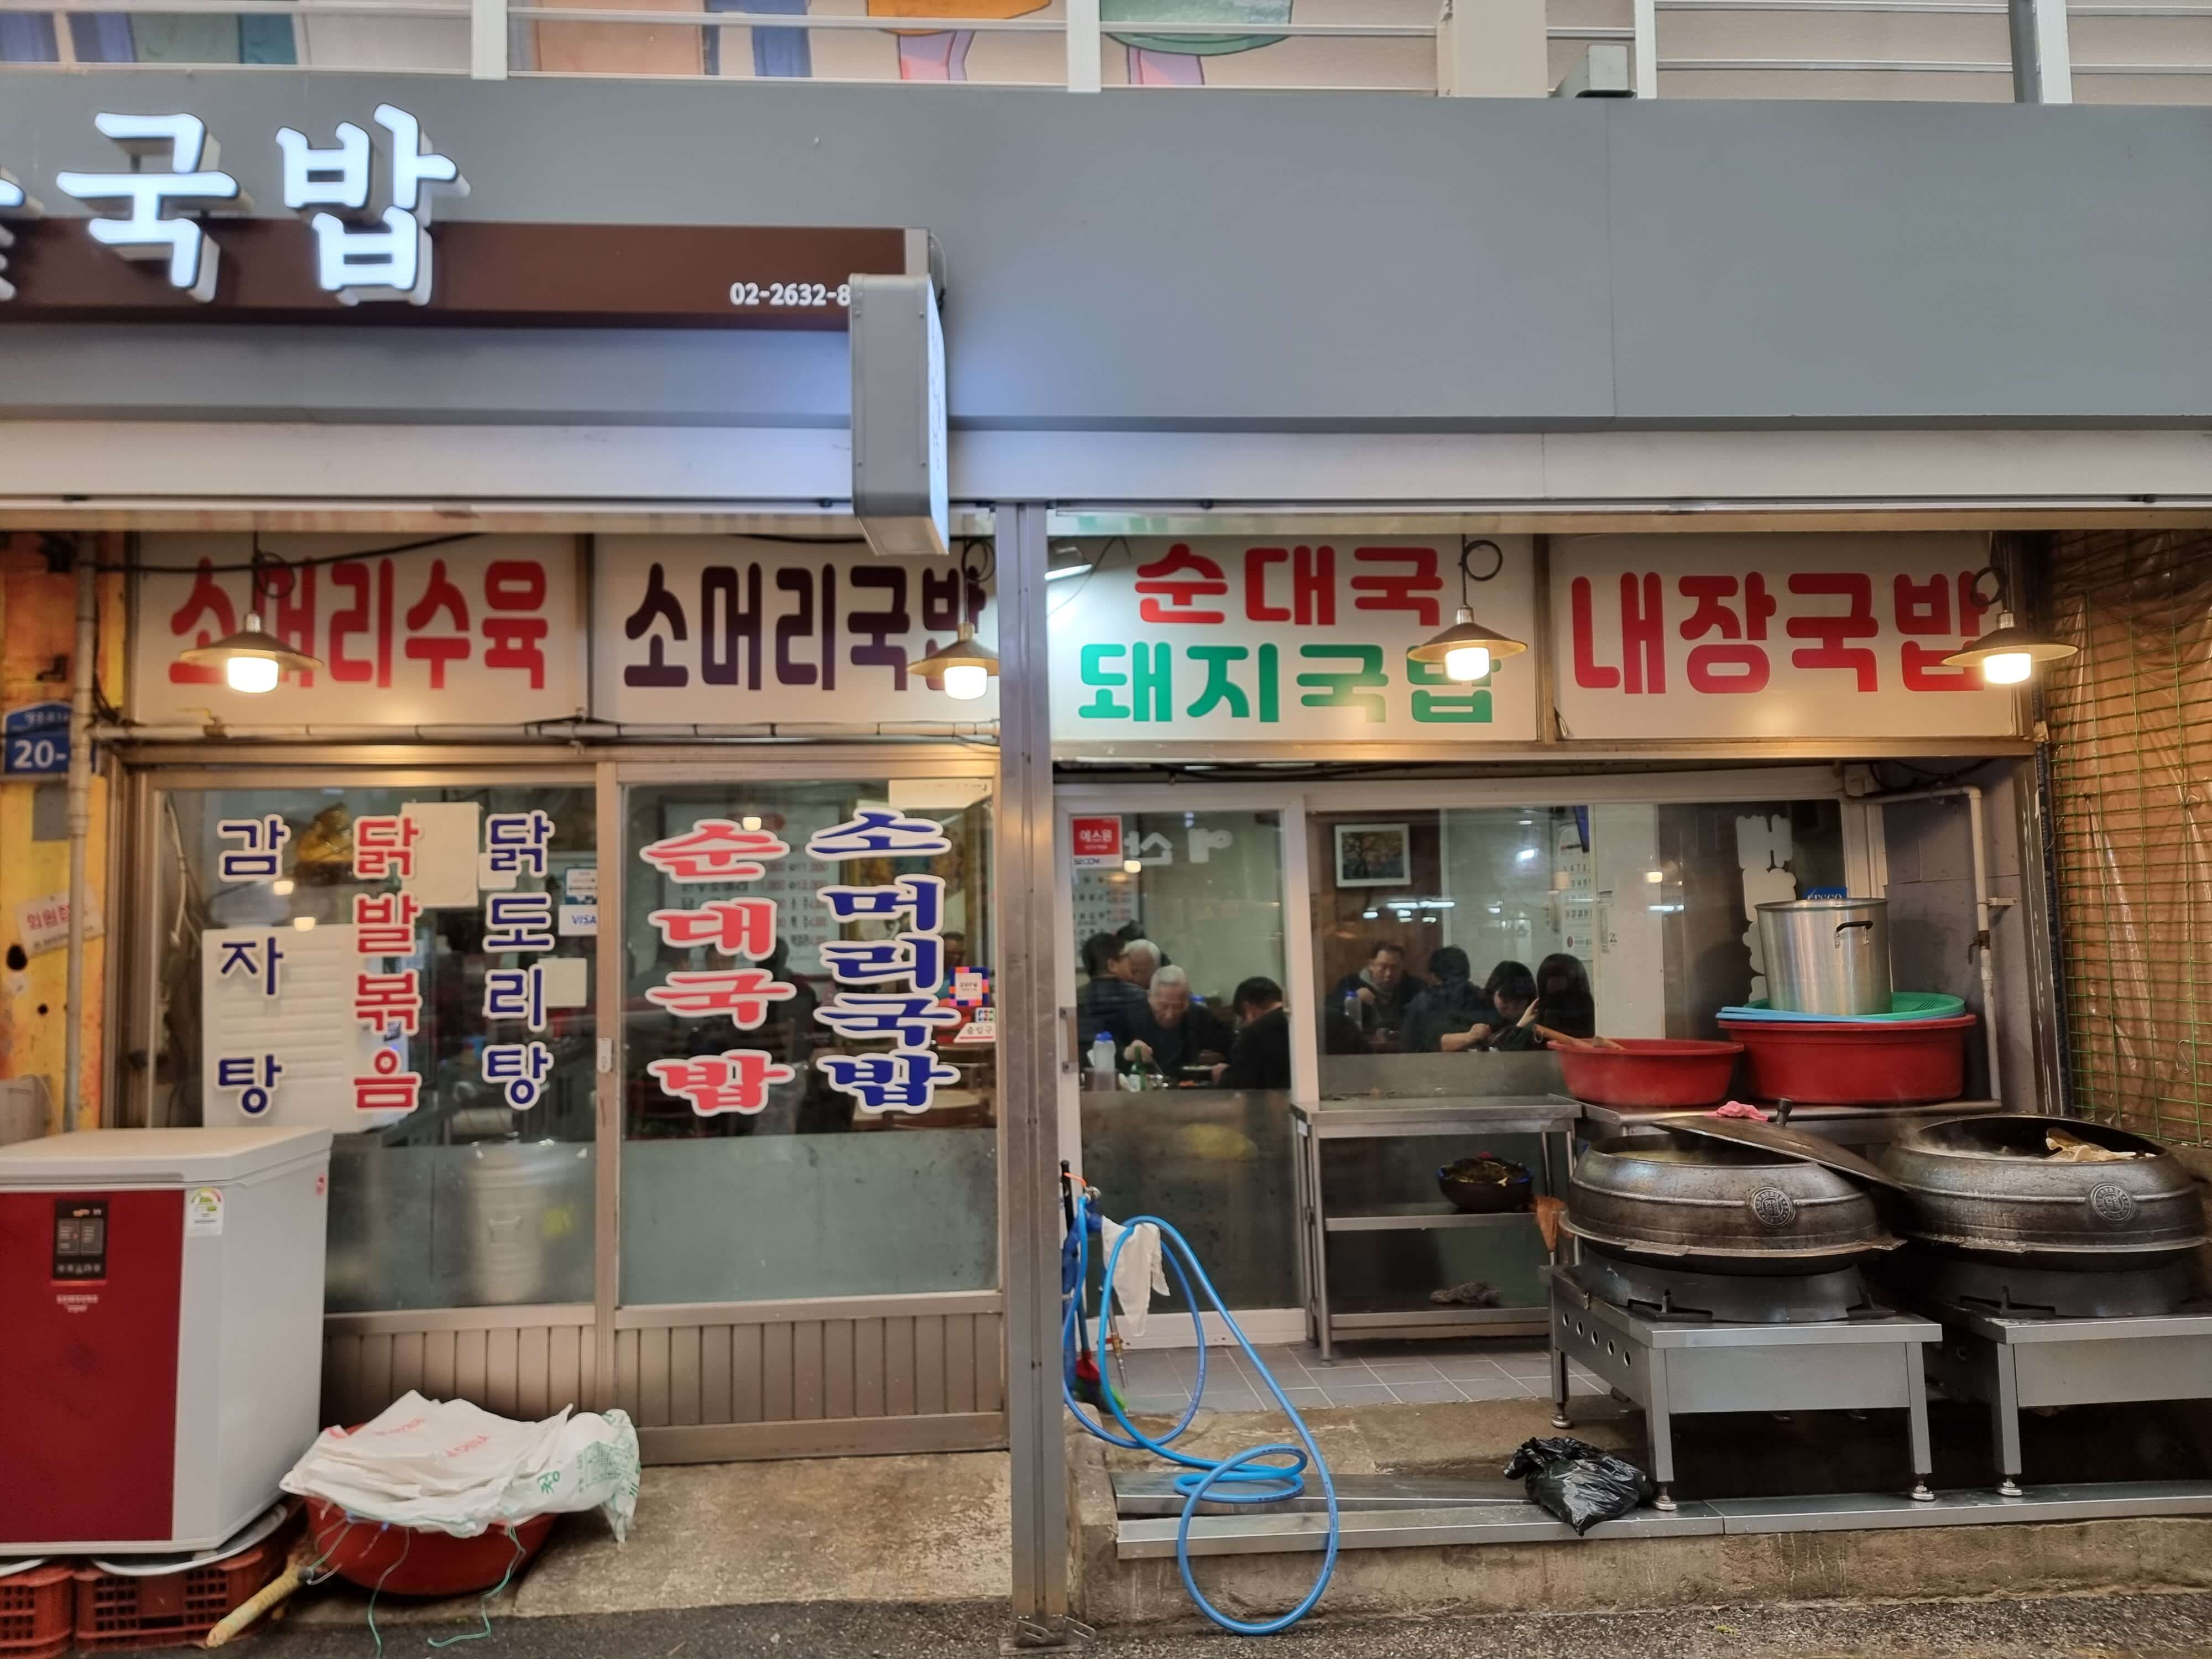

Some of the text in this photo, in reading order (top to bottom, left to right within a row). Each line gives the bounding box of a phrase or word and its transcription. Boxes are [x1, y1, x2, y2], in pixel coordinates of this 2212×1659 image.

[0, 103, 460, 294] 국밥
[729, 282, 851, 306] 02-2632-8
[1135, 543, 1443, 625] 순대국
[1572, 571, 1990, 695] 내장국밥
[571, 915, 597, 925] VISA
[1079, 830, 1113, 842] 에스원
[217, 817, 288, 1115] 감자탕
[353, 815, 422, 1110] 닭발볶음
[483, 813, 554, 1107] 닭도리탕
[642, 821, 794, 1113] 순대국밥
[809, 811, 959, 1110] 소머리국밥
